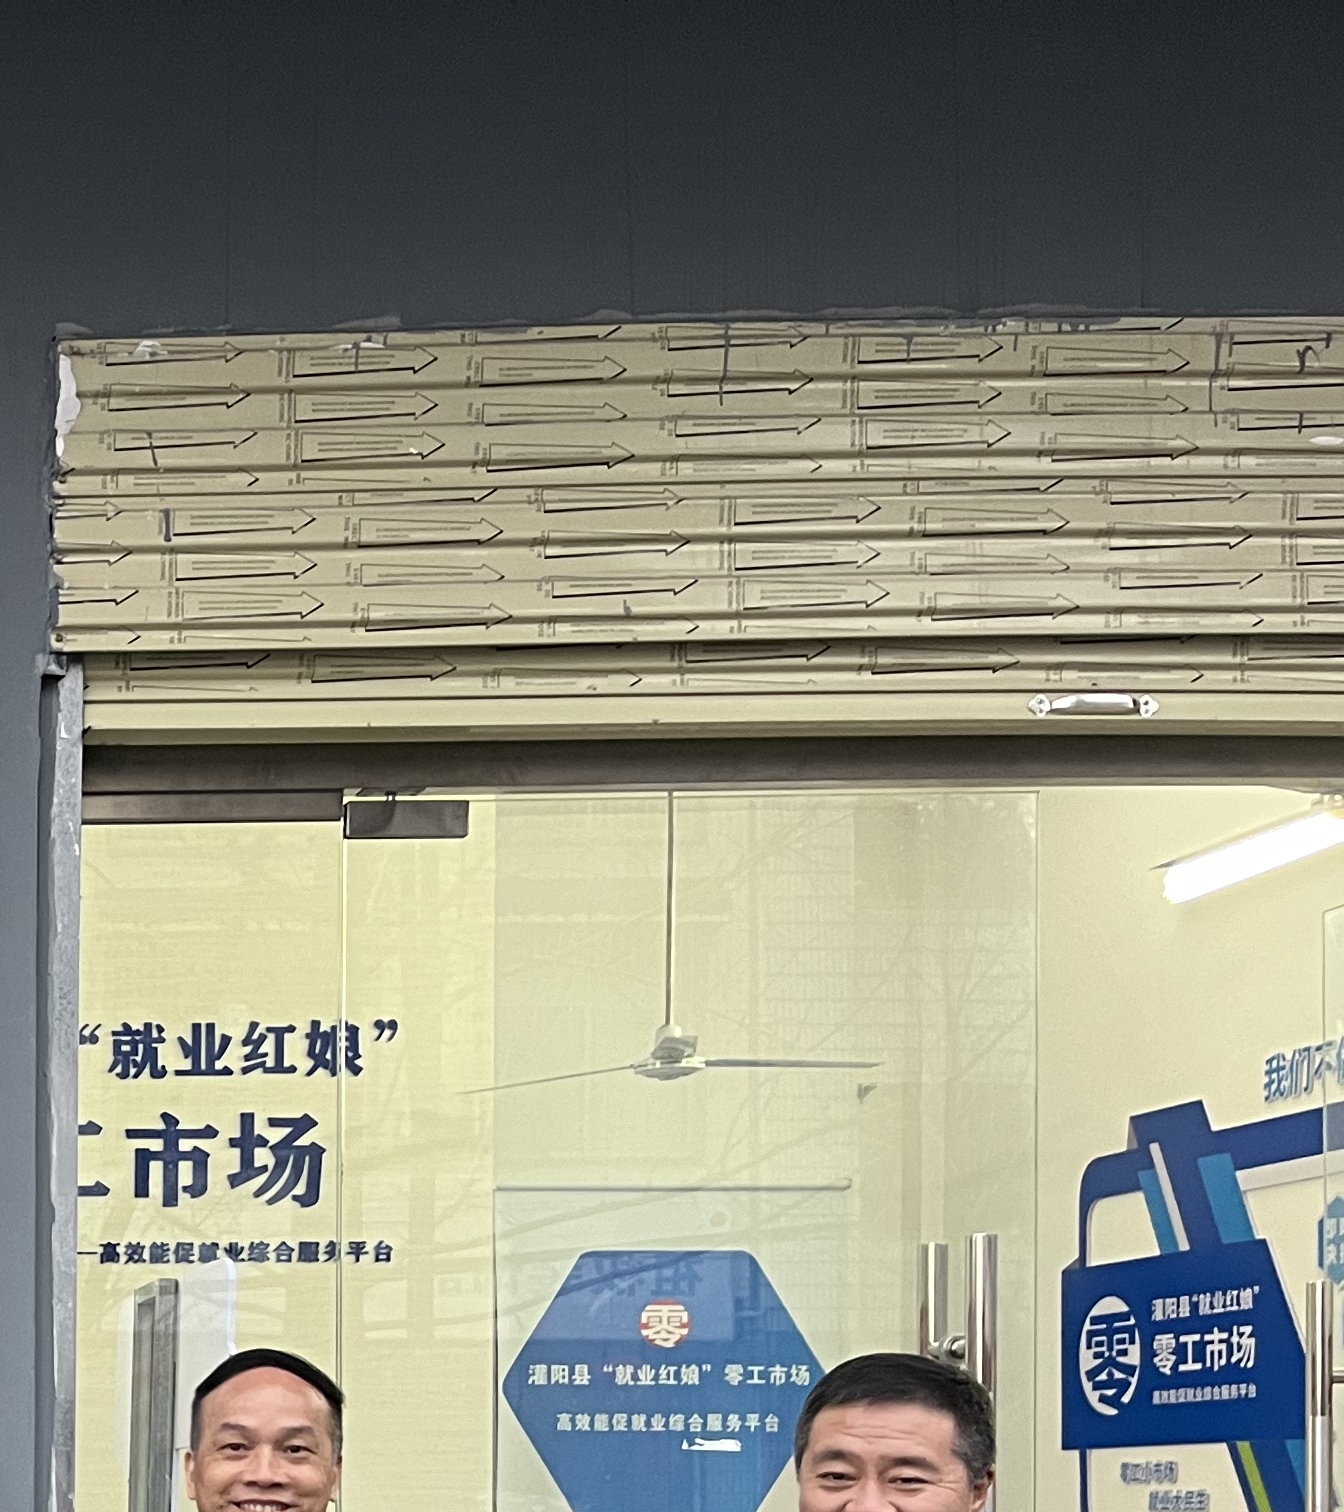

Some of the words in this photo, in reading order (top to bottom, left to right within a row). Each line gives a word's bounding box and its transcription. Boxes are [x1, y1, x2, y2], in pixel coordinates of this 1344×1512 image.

[1152, 1325, 1256, 1376] 零工市场
[556, 1412, 781, 1433] 高效能促就业综合服务平台
